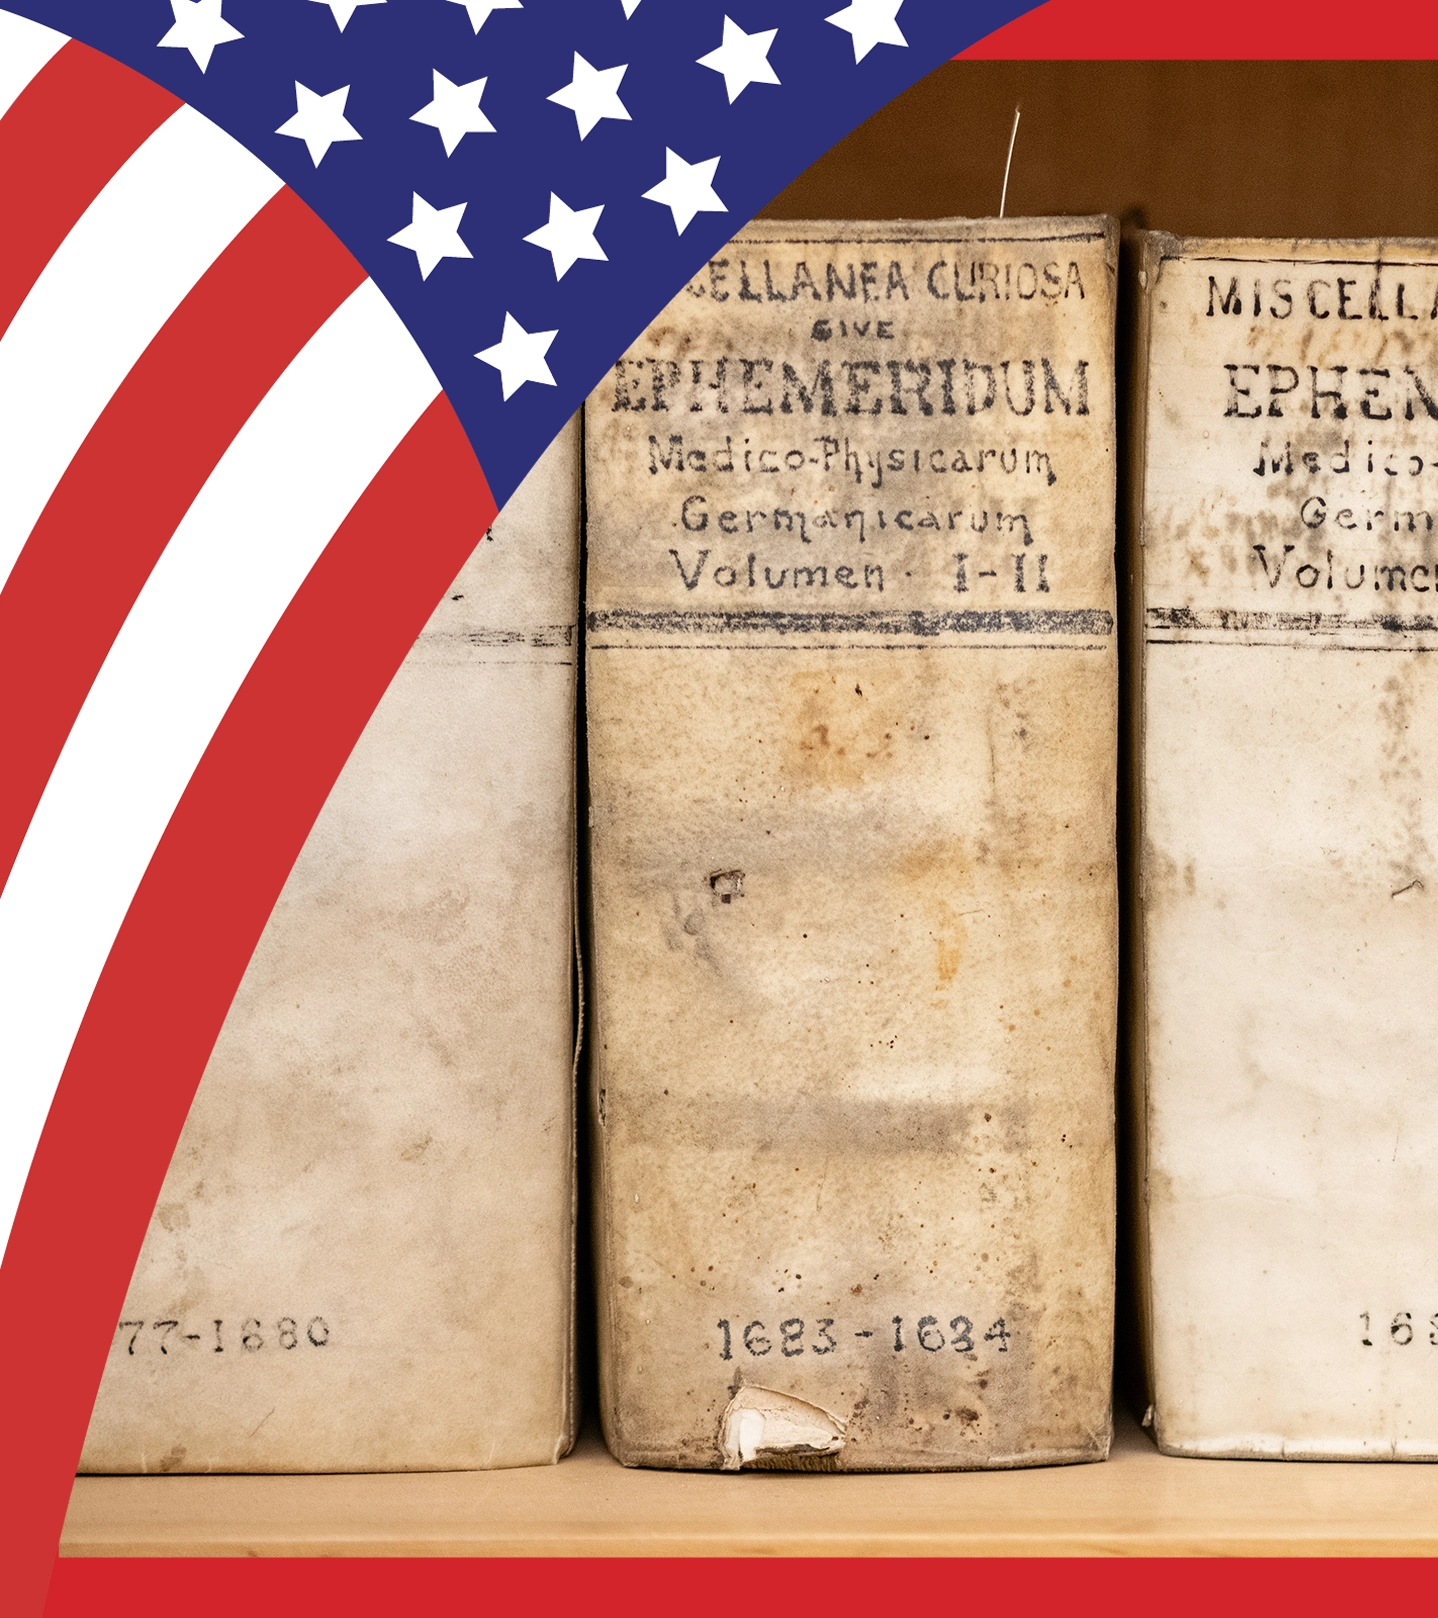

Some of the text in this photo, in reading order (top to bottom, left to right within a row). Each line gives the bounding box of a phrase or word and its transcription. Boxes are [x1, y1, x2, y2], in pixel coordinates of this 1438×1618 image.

[686, 258, 1086, 304] ELLANEA CURIOSA
[811, 319, 895, 341] SIVE
[611, 356, 1090, 417] EPHEMERIDUM
[681, 494, 1034, 545] Germanicarum
[669, 548, 1050, 592] Volumen I-II
